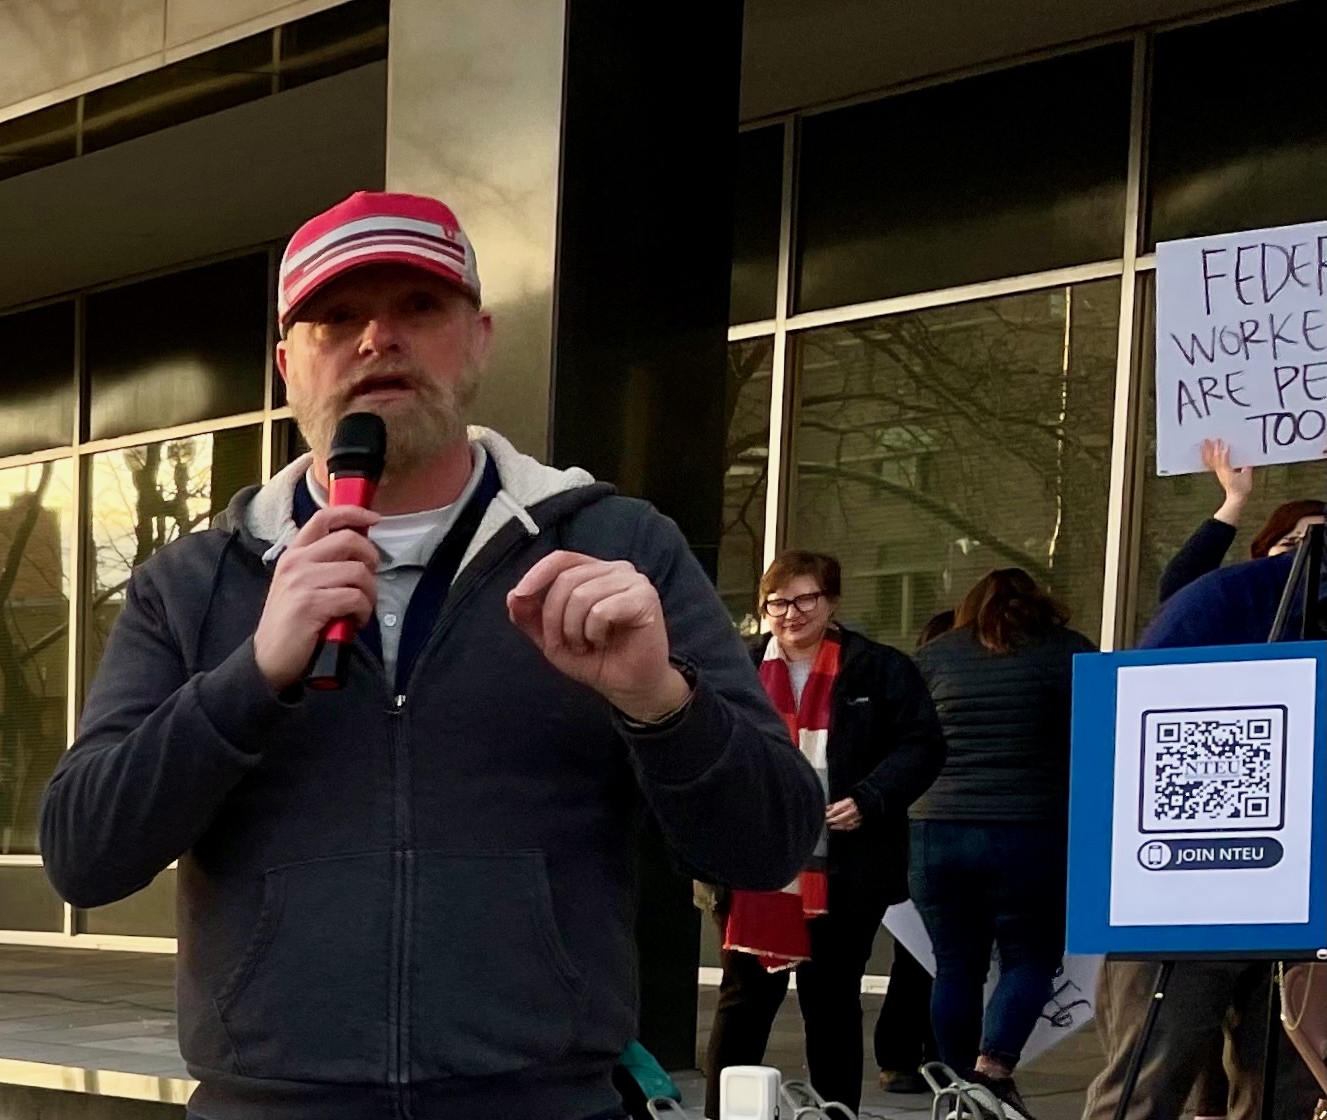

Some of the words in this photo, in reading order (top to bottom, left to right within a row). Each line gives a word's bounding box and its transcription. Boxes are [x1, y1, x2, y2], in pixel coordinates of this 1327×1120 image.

[1177, 370, 1251, 427] ARE
[1246, 409, 1326, 454] TOO
[1186, 760, 1239, 775] NTEU
[1175, 848, 1214, 865] JOIN
[1219, 847, 1264, 861] NTEU
